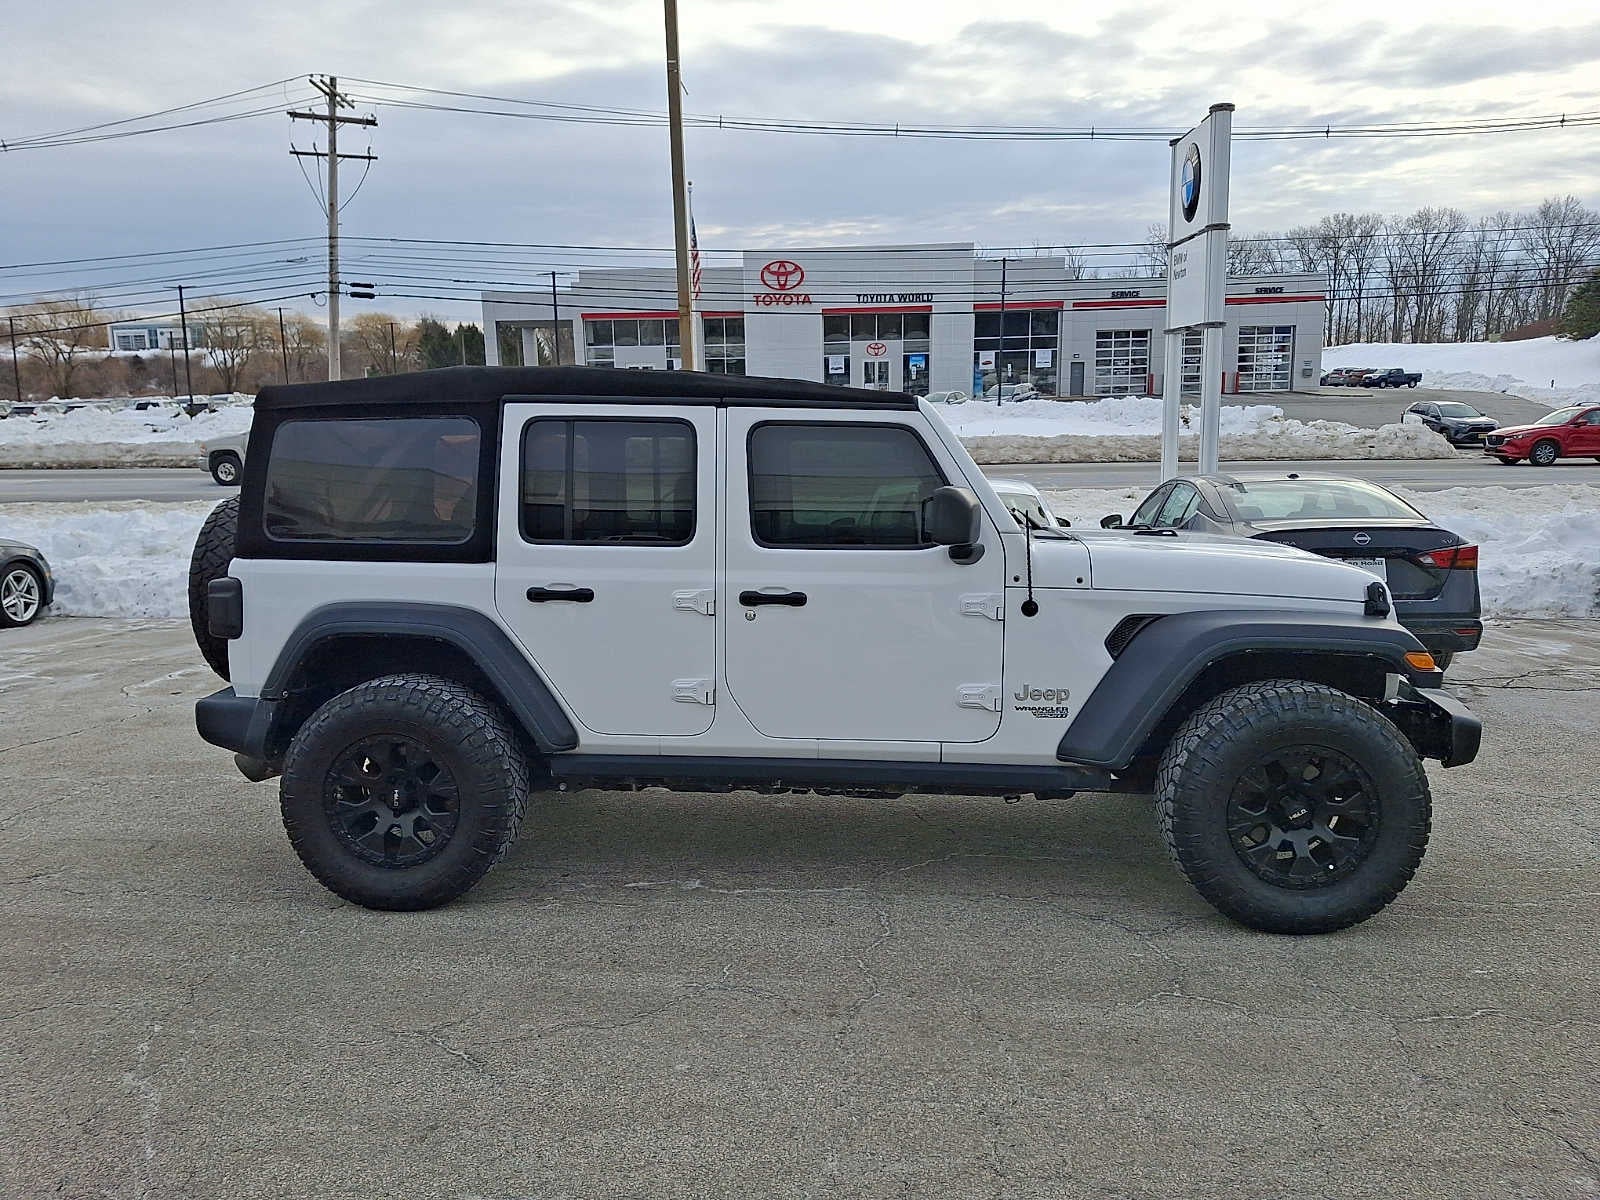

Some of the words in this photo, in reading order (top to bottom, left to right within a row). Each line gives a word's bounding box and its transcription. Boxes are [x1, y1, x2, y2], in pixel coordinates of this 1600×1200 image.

[1111, 290, 1141, 299] SERVICE
[1255, 286, 1285, 294] SERVICE
[753, 293, 812, 306] TOYOTA
[856, 293, 894, 304] TOYOTA
[897, 292, 934, 303] WORLD
[1014, 683, 1071, 704] Jeep
